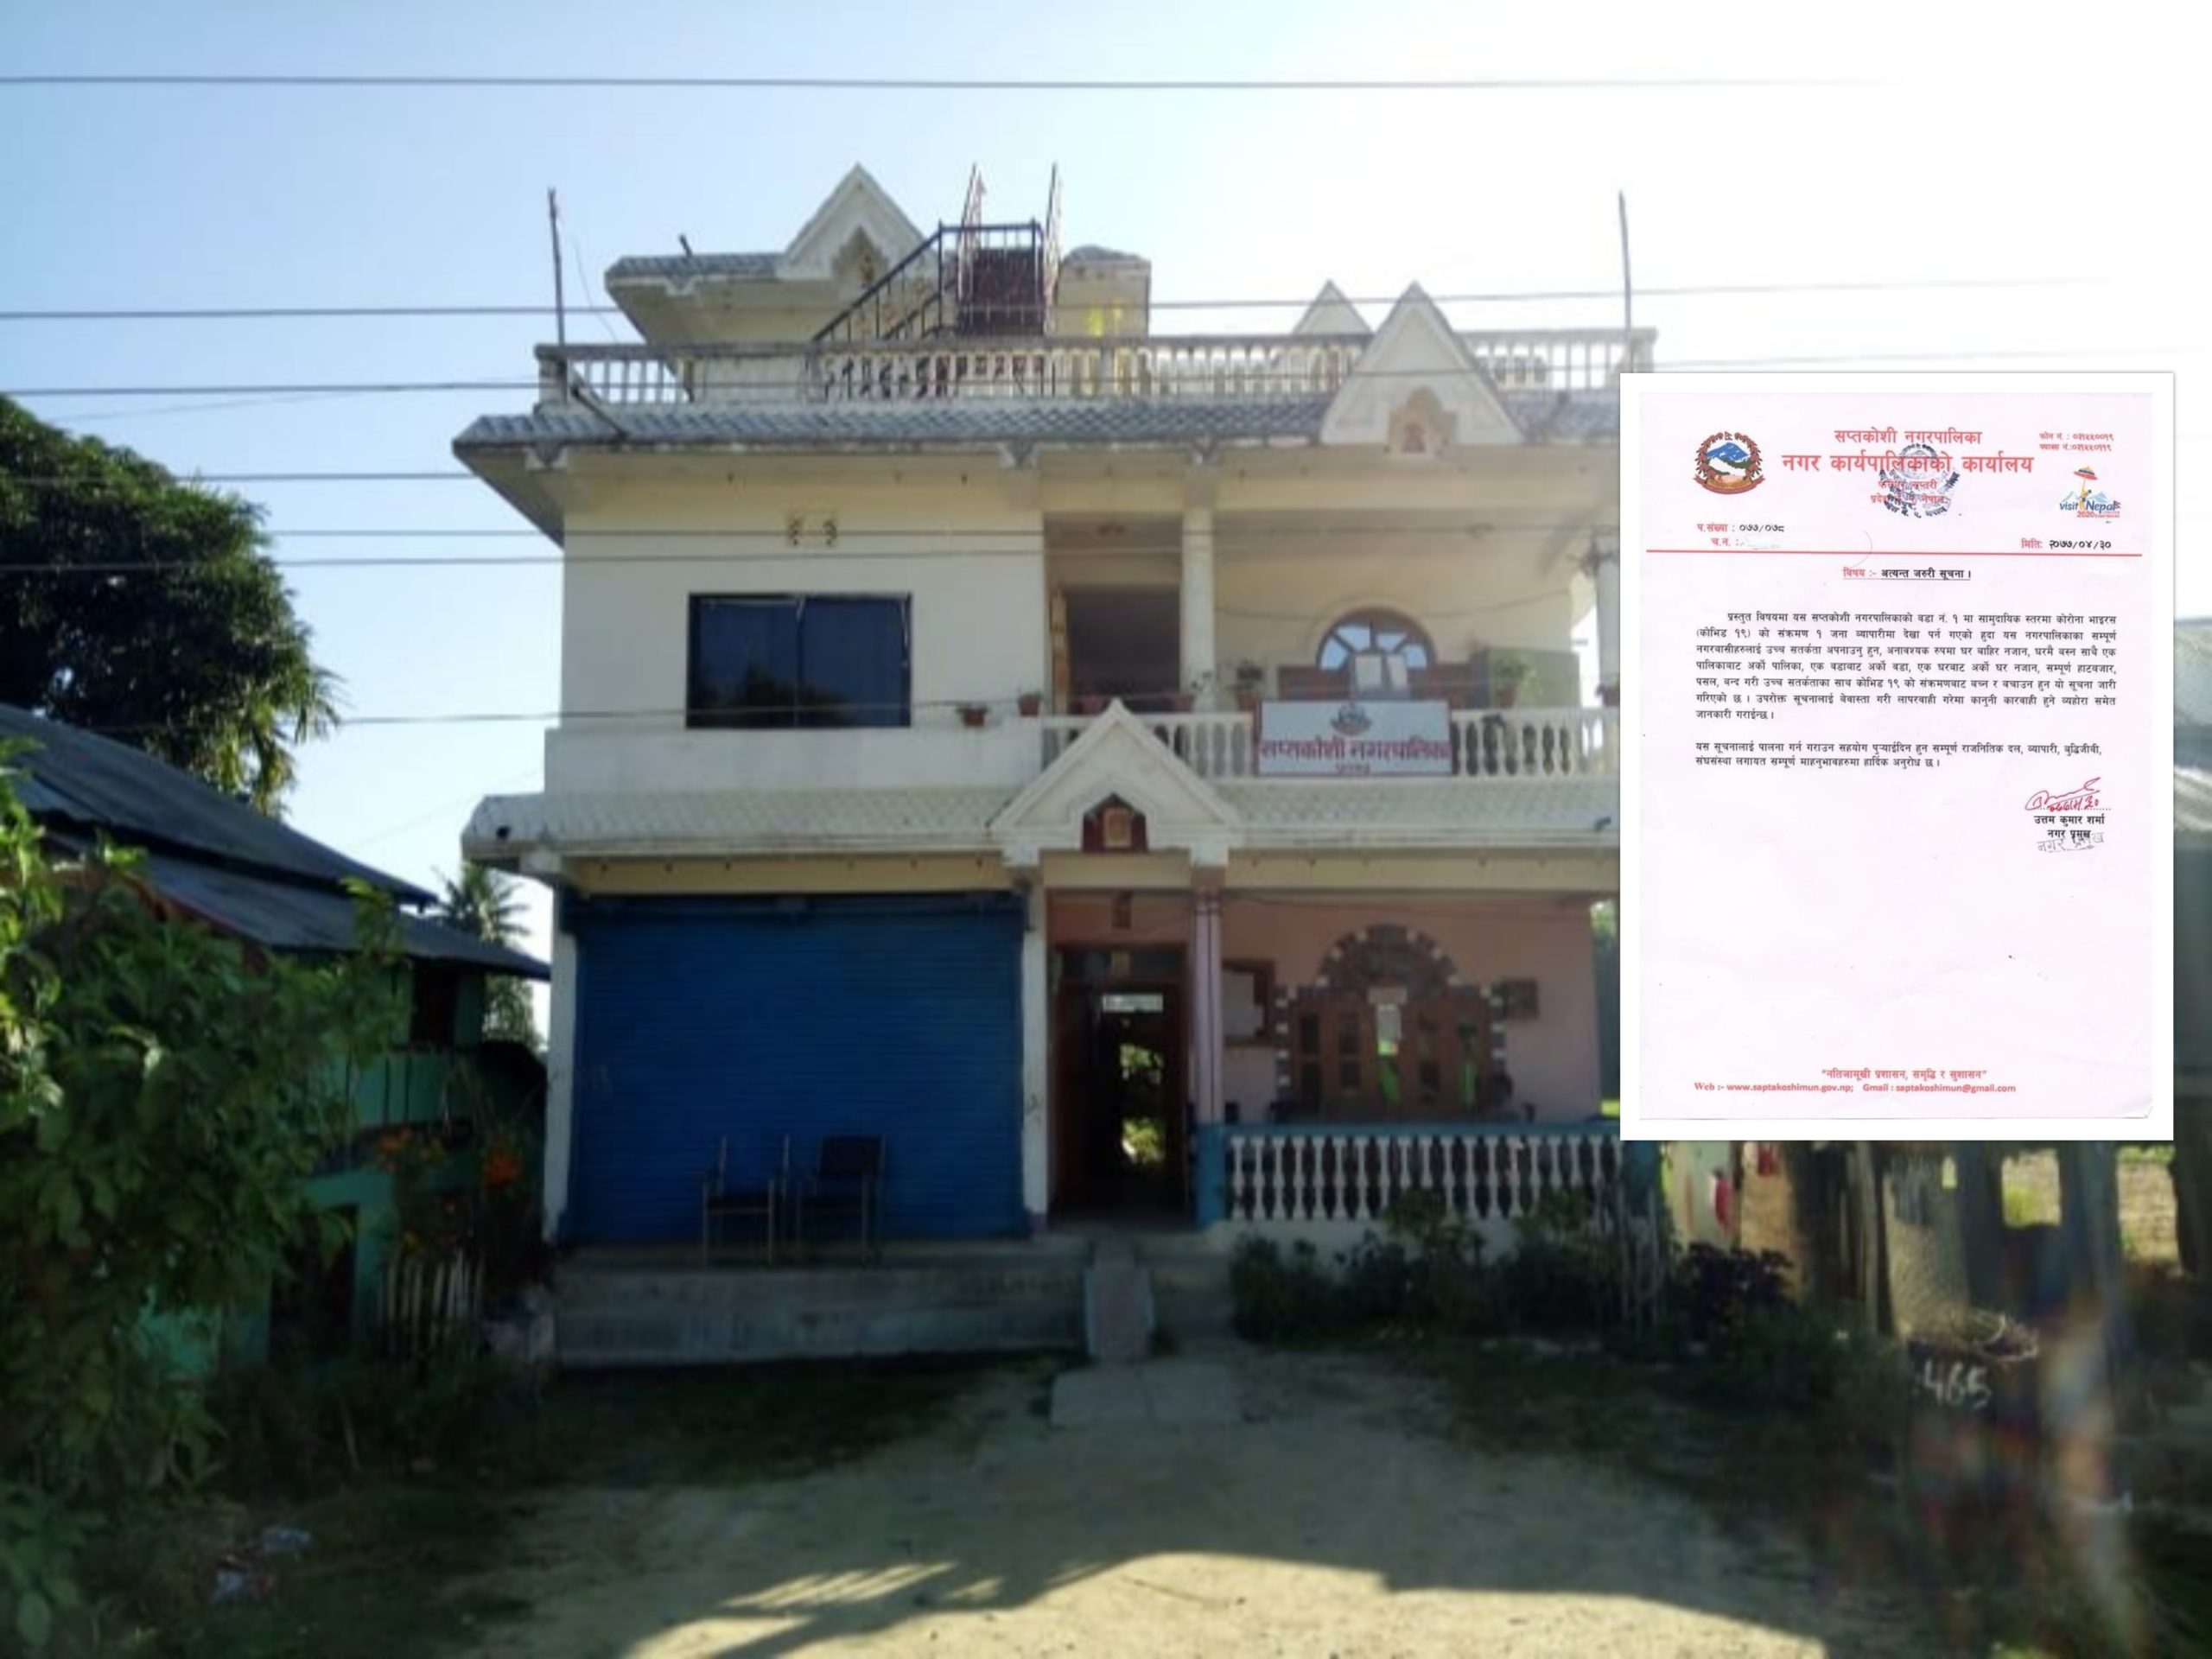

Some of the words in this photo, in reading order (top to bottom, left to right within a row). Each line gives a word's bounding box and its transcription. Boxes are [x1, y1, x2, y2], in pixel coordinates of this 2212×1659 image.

[1834, 427, 1898, 444] सप्तकोशी
[1904, 427, 1983, 445] नगरपालिका
[1782, 454, 1822, 472] नगर
[1829, 449, 1952, 474] कार्यपालिकाको
[1961, 449, 2034, 474] कार्यालय
[2059, 501, 2079, 512] visit
[2085, 499, 2116, 513] Nepal
[2076, 510, 2095, 518] 2020
[1738, 523, 1785, 533] ०७७/०७८
[2049, 539, 2113, 550] २०७७/०४/३०
[1842, 566, 1866, 577] विषय
[1880, 569, 1910, 578] अत्यन्त
[1912, 567, 1936, 578] जरुरी
[1938, 569, 1965, 580] सूचना
[1727, 613, 1752, 625] प्रस्तुत
[1756, 610, 1789, 622] विषयमा
[1792, 613, 1808, 622] यस
[1810, 611, 1851, 622] सप्तकोशी
[1854, 611, 1914, 623] नगरपालिकाको
[1916, 613, 1935, 624] वडा
[1938, 613, 1948, 624] नं.
[1952, 613, 1958, 625] १
[1962, 614, 1974, 624] मा
[1978, 612, 2022, 626] सामुदायिक
[2024, 614, 2052, 624] स्तरमा
[2056, 613, 2084, 625] कोरोना
[2088, 615, 2117, 626] भाइरस
[1696, 626, 1728, 639] (कोभिड
[1734, 628, 1751, 639] १९)
[1758, 626, 1770, 638] को
[1777, 627, 1809, 639] संक्रमण
[1815, 629, 1822, 639] १
[1829, 629, 1849, 639] जना
[1855, 627, 1897, 639] व्यापारीमा
[1903, 627, 1921, 639] देखा
[1927, 627, 1942, 639] पर्न
[1948, 628, 1974, 641] गएको
[2002, 631, 2018, 640] यस
[2024, 628, 2084, 640] नगरपालिकाका
[2091, 629, 2118, 644] सम्पूर्ण
[1765, 645, 1786, 655] उच्च
[1789, 643, 1822, 655] सतर्कता
[1886, 646, 1930, 656] अनावश्यक
[1933, 646, 1957, 656] रुपमा
[1960, 646, 1974, 656] घर
[2004, 647, 2031, 658] नजान,
[2034, 644, 2055, 657] घरमै
[2101, 648, 2117, 658] एक
[1747, 658, 1766, 671] अर्को
[1771, 658, 1804, 672] पालिका,
[1809, 662, 1825, 672] एक
[1867, 659, 1887, 671] अर्को
[1891, 663, 1911, 673] वडा,
[1916, 663, 1932, 673] एक
[1971, 660, 1991, 672] अर्को
[1994, 663, 2009, 672] घर
[2013, 663, 2040, 674] नजान,
[2045, 661, 2072, 676] सम्पूर्ण
[1695, 677, 1719, 688] पसल,
[1744, 675, 1760, 687] गरी
[1763, 677, 1784, 688] उच्च
[1787, 676, 1831, 687] सतर्कताका
[1834, 678, 1853, 688] साथ
[1855, 676, 1885, 689] कोभिड
[1887, 678, 1900, 689] १९
[1904, 677, 1916, 688] को
[1992, 680, 1999, 689] र
[2037, 680, 2051, 692] हुन
[2054, 677, 2065, 690] यो
[2068, 680, 2094, 692] सूचना
[2097, 678, 2117, 690] जारी
[1695, 690, 1727, 704] गरिएको
[1732, 694, 1742, 703] छ
[1756, 691, 1788, 703] उपरोक्त
[1792, 692, 1834, 706] सूचनालाई
[1876, 692, 1892, 704] गरी
[1897, 693, 1937, 705] लापरवाही
[1942, 693, 1965, 705] गरेमा
[1970, 693, 1998, 708] कानुनी
[2003, 693, 2037, 705] कारवाही
[2043, 694, 2056, 709] हुने
[2061, 694, 2089, 706] व्यहोरा
[2094, 694, 2117, 706] समेत
[1695, 708, 1732, 719] जानकारी
[1735, 708, 1769, 720] गराईन्छ
[1694, 742, 1710, 751] यस
[1713, 740, 1755, 754] सूचनालाई
[1758, 743, 1785, 752] पालना
[1788, 740, 1803, 752] गर्न
[1805, 743, 1835, 753] गराउन
[1838, 741, 1869, 753] सहयोग
[1915, 744, 1929, 756] हुन
[1931, 741, 1959, 756] सम्पूर्ण
[1961, 741, 2005, 753] राजनितिक
[2006, 744, 2024, 755] दल,
[2027, 742, 2061, 755] व्यापारी,
[1694, 755, 1732, 766] संघसंस्था
[1735, 757, 1767, 766] लगायत
[1770, 754, 1796, 769] सम्पूर्ण
[1863, 755, 1889, 767] हार्दिक
[1892, 755, 1922, 770] अनुरोध
[1924, 758, 1934, 768] छ
[2033, 815, 2056, 825] उत्तम
[2059, 815, 2083, 828] कुमार
[2086, 813, 2106, 825] शर्मा
[2047, 829, 2067, 839] नगर
[1874, 1070, 1908, 1081] प्रशासन,
[1939, 1071, 1946, 1079] र
[1694, 1082, 1715, 1091] Web
[1726, 1083, 1854, 1094] www.saptakoshimun.gov.np;
[1862, 1083, 1890, 1092] Gmail
[1895, 1083, 2017, 1095] saptakoshimun@gmail.com
